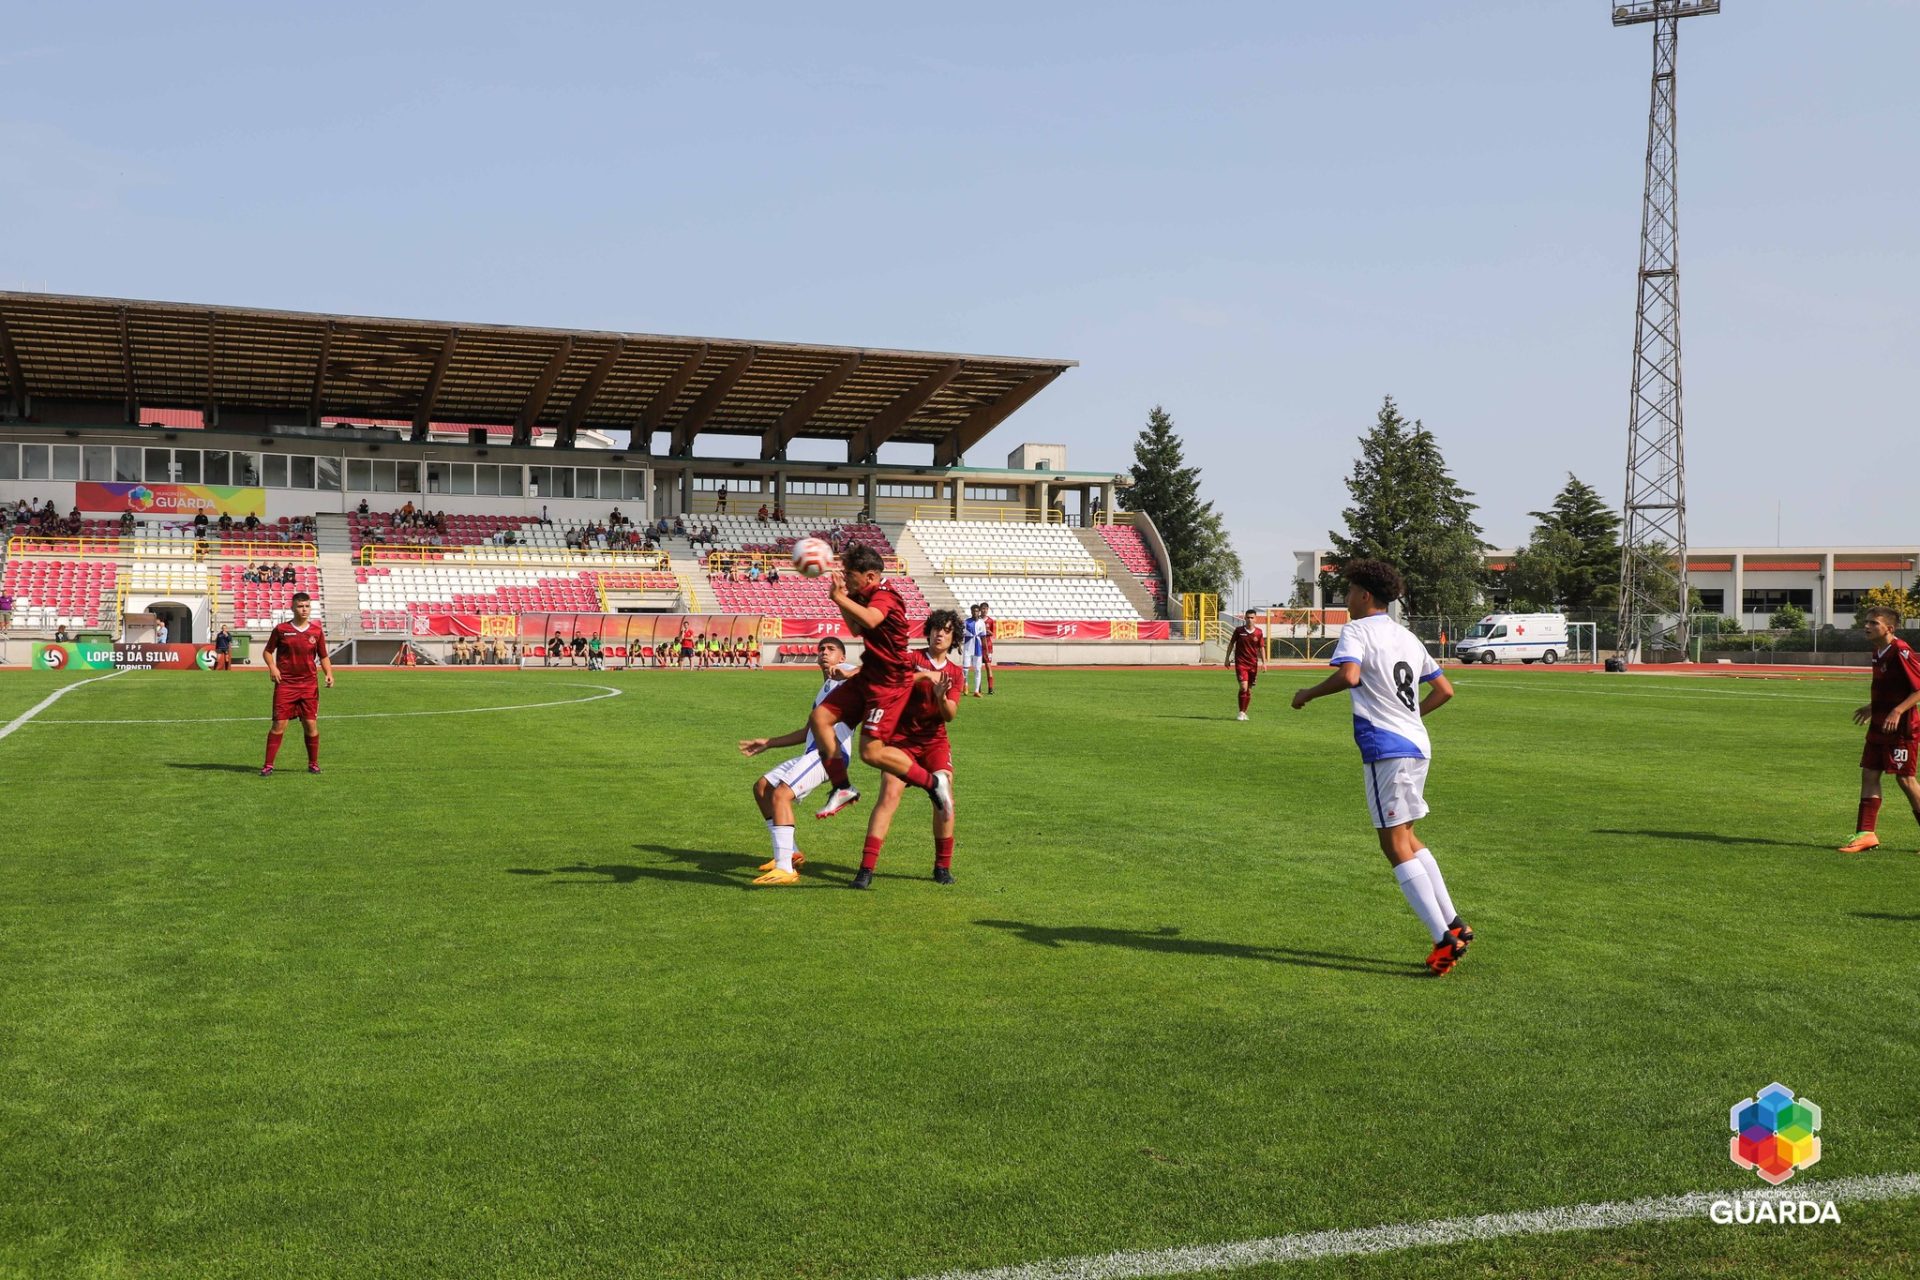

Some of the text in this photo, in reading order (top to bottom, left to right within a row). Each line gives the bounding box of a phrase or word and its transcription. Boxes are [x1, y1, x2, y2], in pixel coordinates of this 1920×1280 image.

[156, 497, 215, 508] GUARDA
[817, 623, 840, 633] FPF
[1057, 624, 1077, 635] FPF
[87, 651, 179, 662] LOPES DA SILVA
[1393, 661, 1415, 712] 8
[867, 708, 884, 723] 18
[1894, 749, 1908, 761] 20
